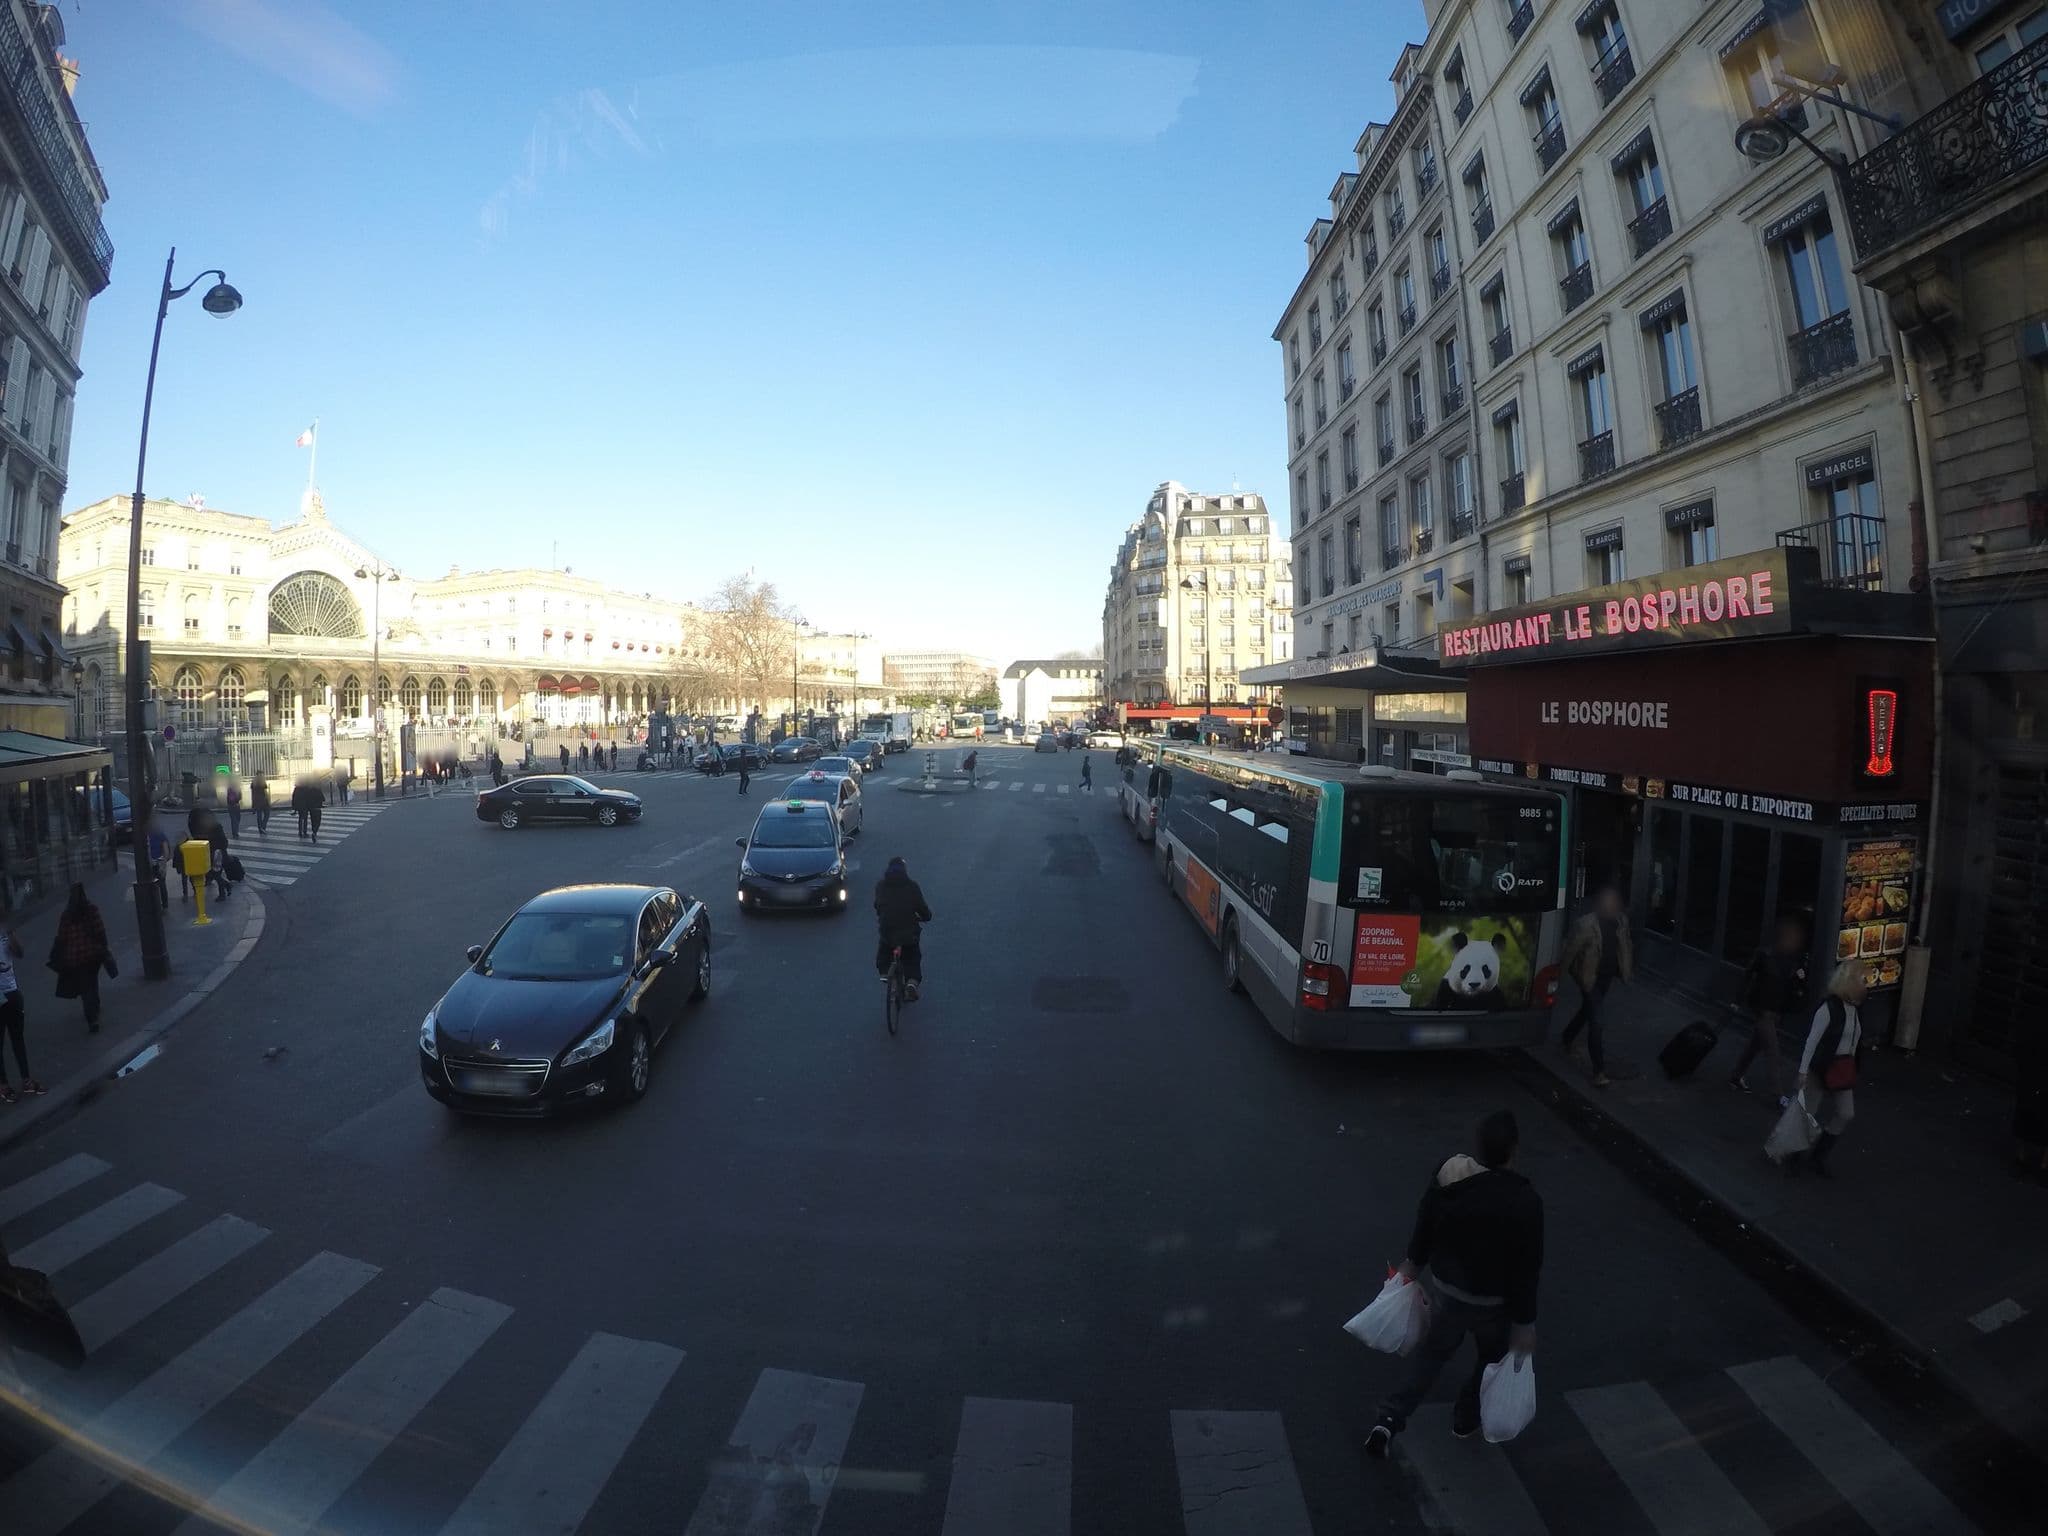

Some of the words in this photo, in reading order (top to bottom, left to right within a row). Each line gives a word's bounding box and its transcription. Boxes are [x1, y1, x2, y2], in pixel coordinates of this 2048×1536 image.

[1767, 227, 1780, 240] LE
[1781, 201, 1820, 230] MARCEL
[1568, 363, 1578, 373] LE
[1577, 350, 1600, 368] MARCEL
[1808, 470, 1822, 481] LE
[1824, 456, 1868, 477] MARCEL
[1674, 507, 1702, 522] HÔTEL
[1586, 538, 1595, 548] LE
[1595, 532, 1619, 546] MARCEL
[1444, 613, 1551, 657] RESTAURANT
[1564, 605, 1592, 640] LE
[1605, 571, 1774, 636] BOSPHORE
[1541, 701, 1559, 724] LE
[1568, 701, 1669, 728] BOSPHORE
[1877, 697, 1887, 754] KEBAB
[1550, 767, 1581, 783] FORMULE
[1581, 771, 1606, 788] RAPIDE
[1519, 808, 1541, 818] 9885
[1672, 784, 1688, 800] SUR
[1691, 787, 1722, 806] PLACE
[1725, 792, 1739, 809] OU
[1741, 795, 1749, 810] A
[1752, 796, 1813, 821] EMPORTER
[1518, 879, 1544, 887] RATP
[1360, 937, 1370, 945] DE
[1372, 937, 1404, 946] BEAUVAL
[1361, 928, 1395, 936] ZOOPARC
[1313, 942, 1328, 961] 70
